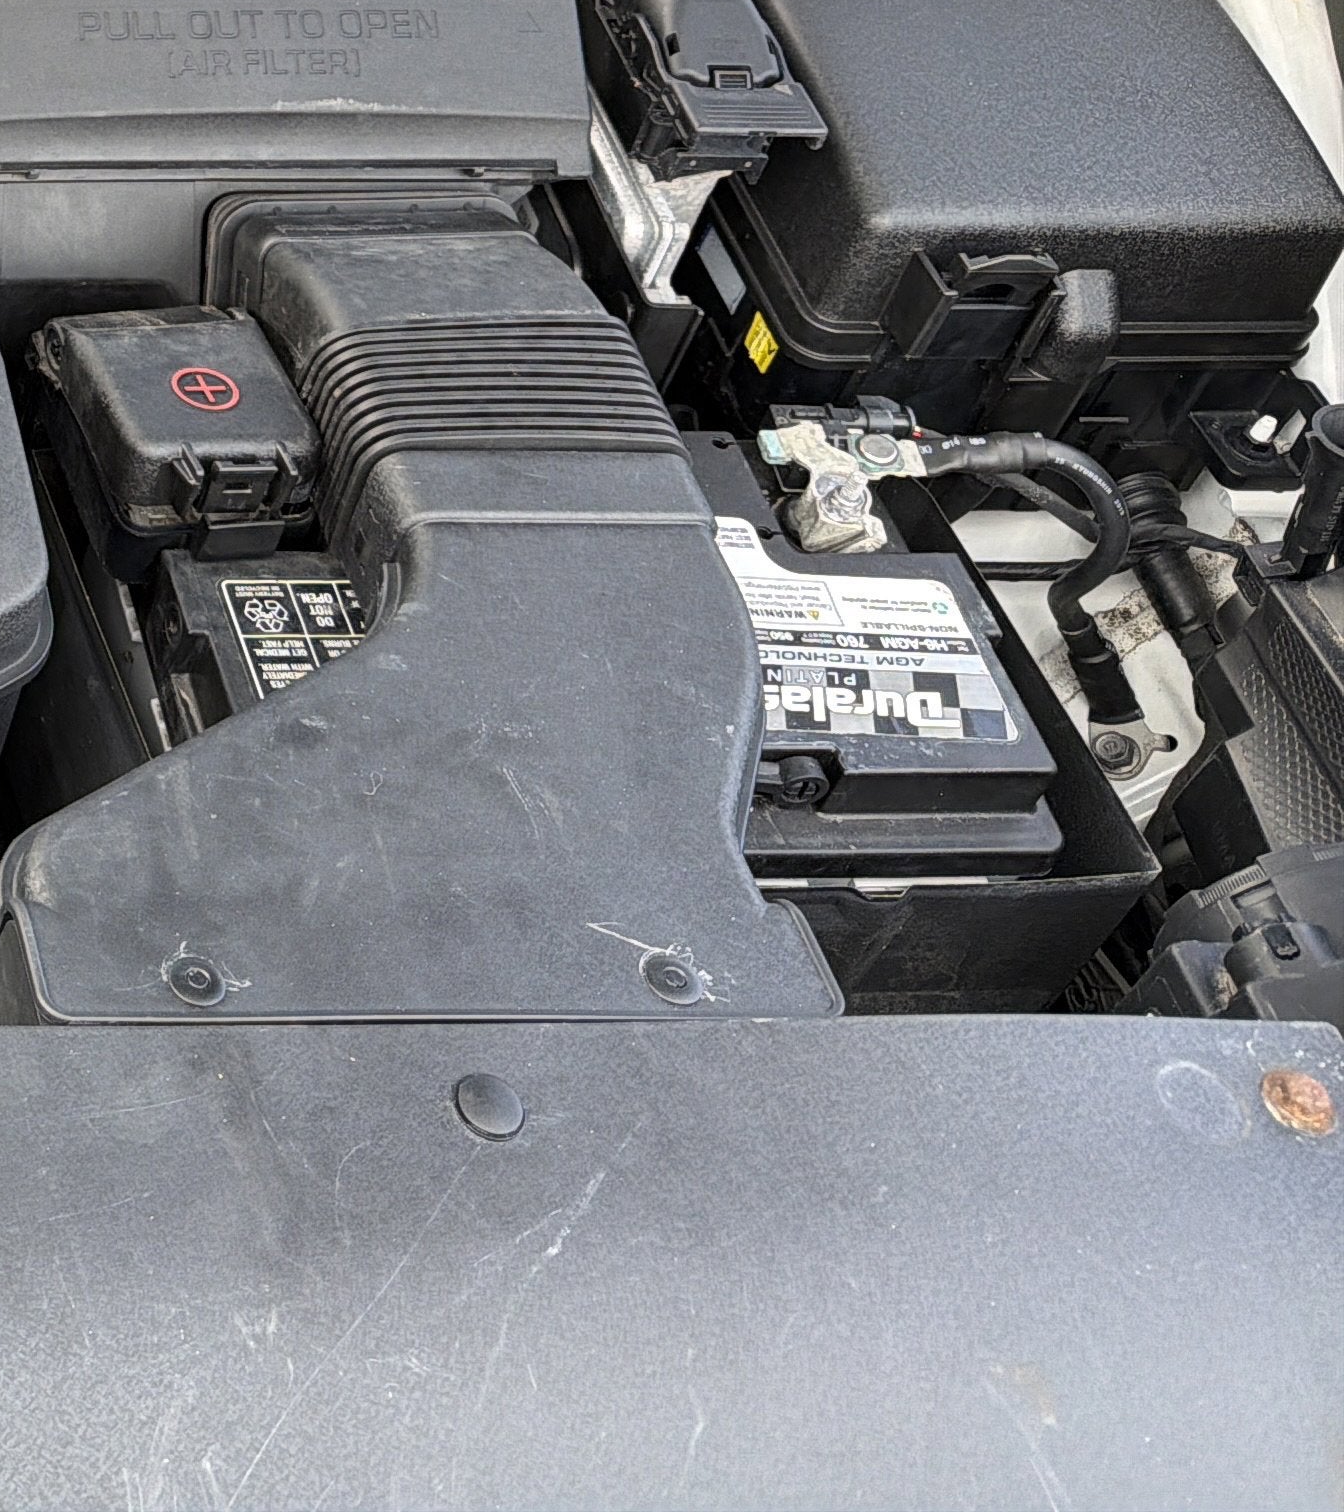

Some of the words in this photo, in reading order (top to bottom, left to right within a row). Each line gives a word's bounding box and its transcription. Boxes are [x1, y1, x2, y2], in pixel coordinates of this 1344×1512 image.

[79, 11, 176, 41] PULL
[188, 11, 264, 40] OUT
[275, 10, 326, 39] TO
[339, 9, 439, 40] OPEN
[296, 592, 334, 604] OPEN.
[309, 604, 333, 616] NOT
[749, 608, 808, 620] WARNIN
[316, 616, 336, 627] DO
[861, 622, 959, 634] NON-SPILLABLE
[836, 634, 871, 649] 760
[759, 649, 870, 665] TECHNOLO
[876, 655, 926, 667] AGM
[767, 668, 857, 686] PLATIN
[762, 685, 961, 729] Duralas
